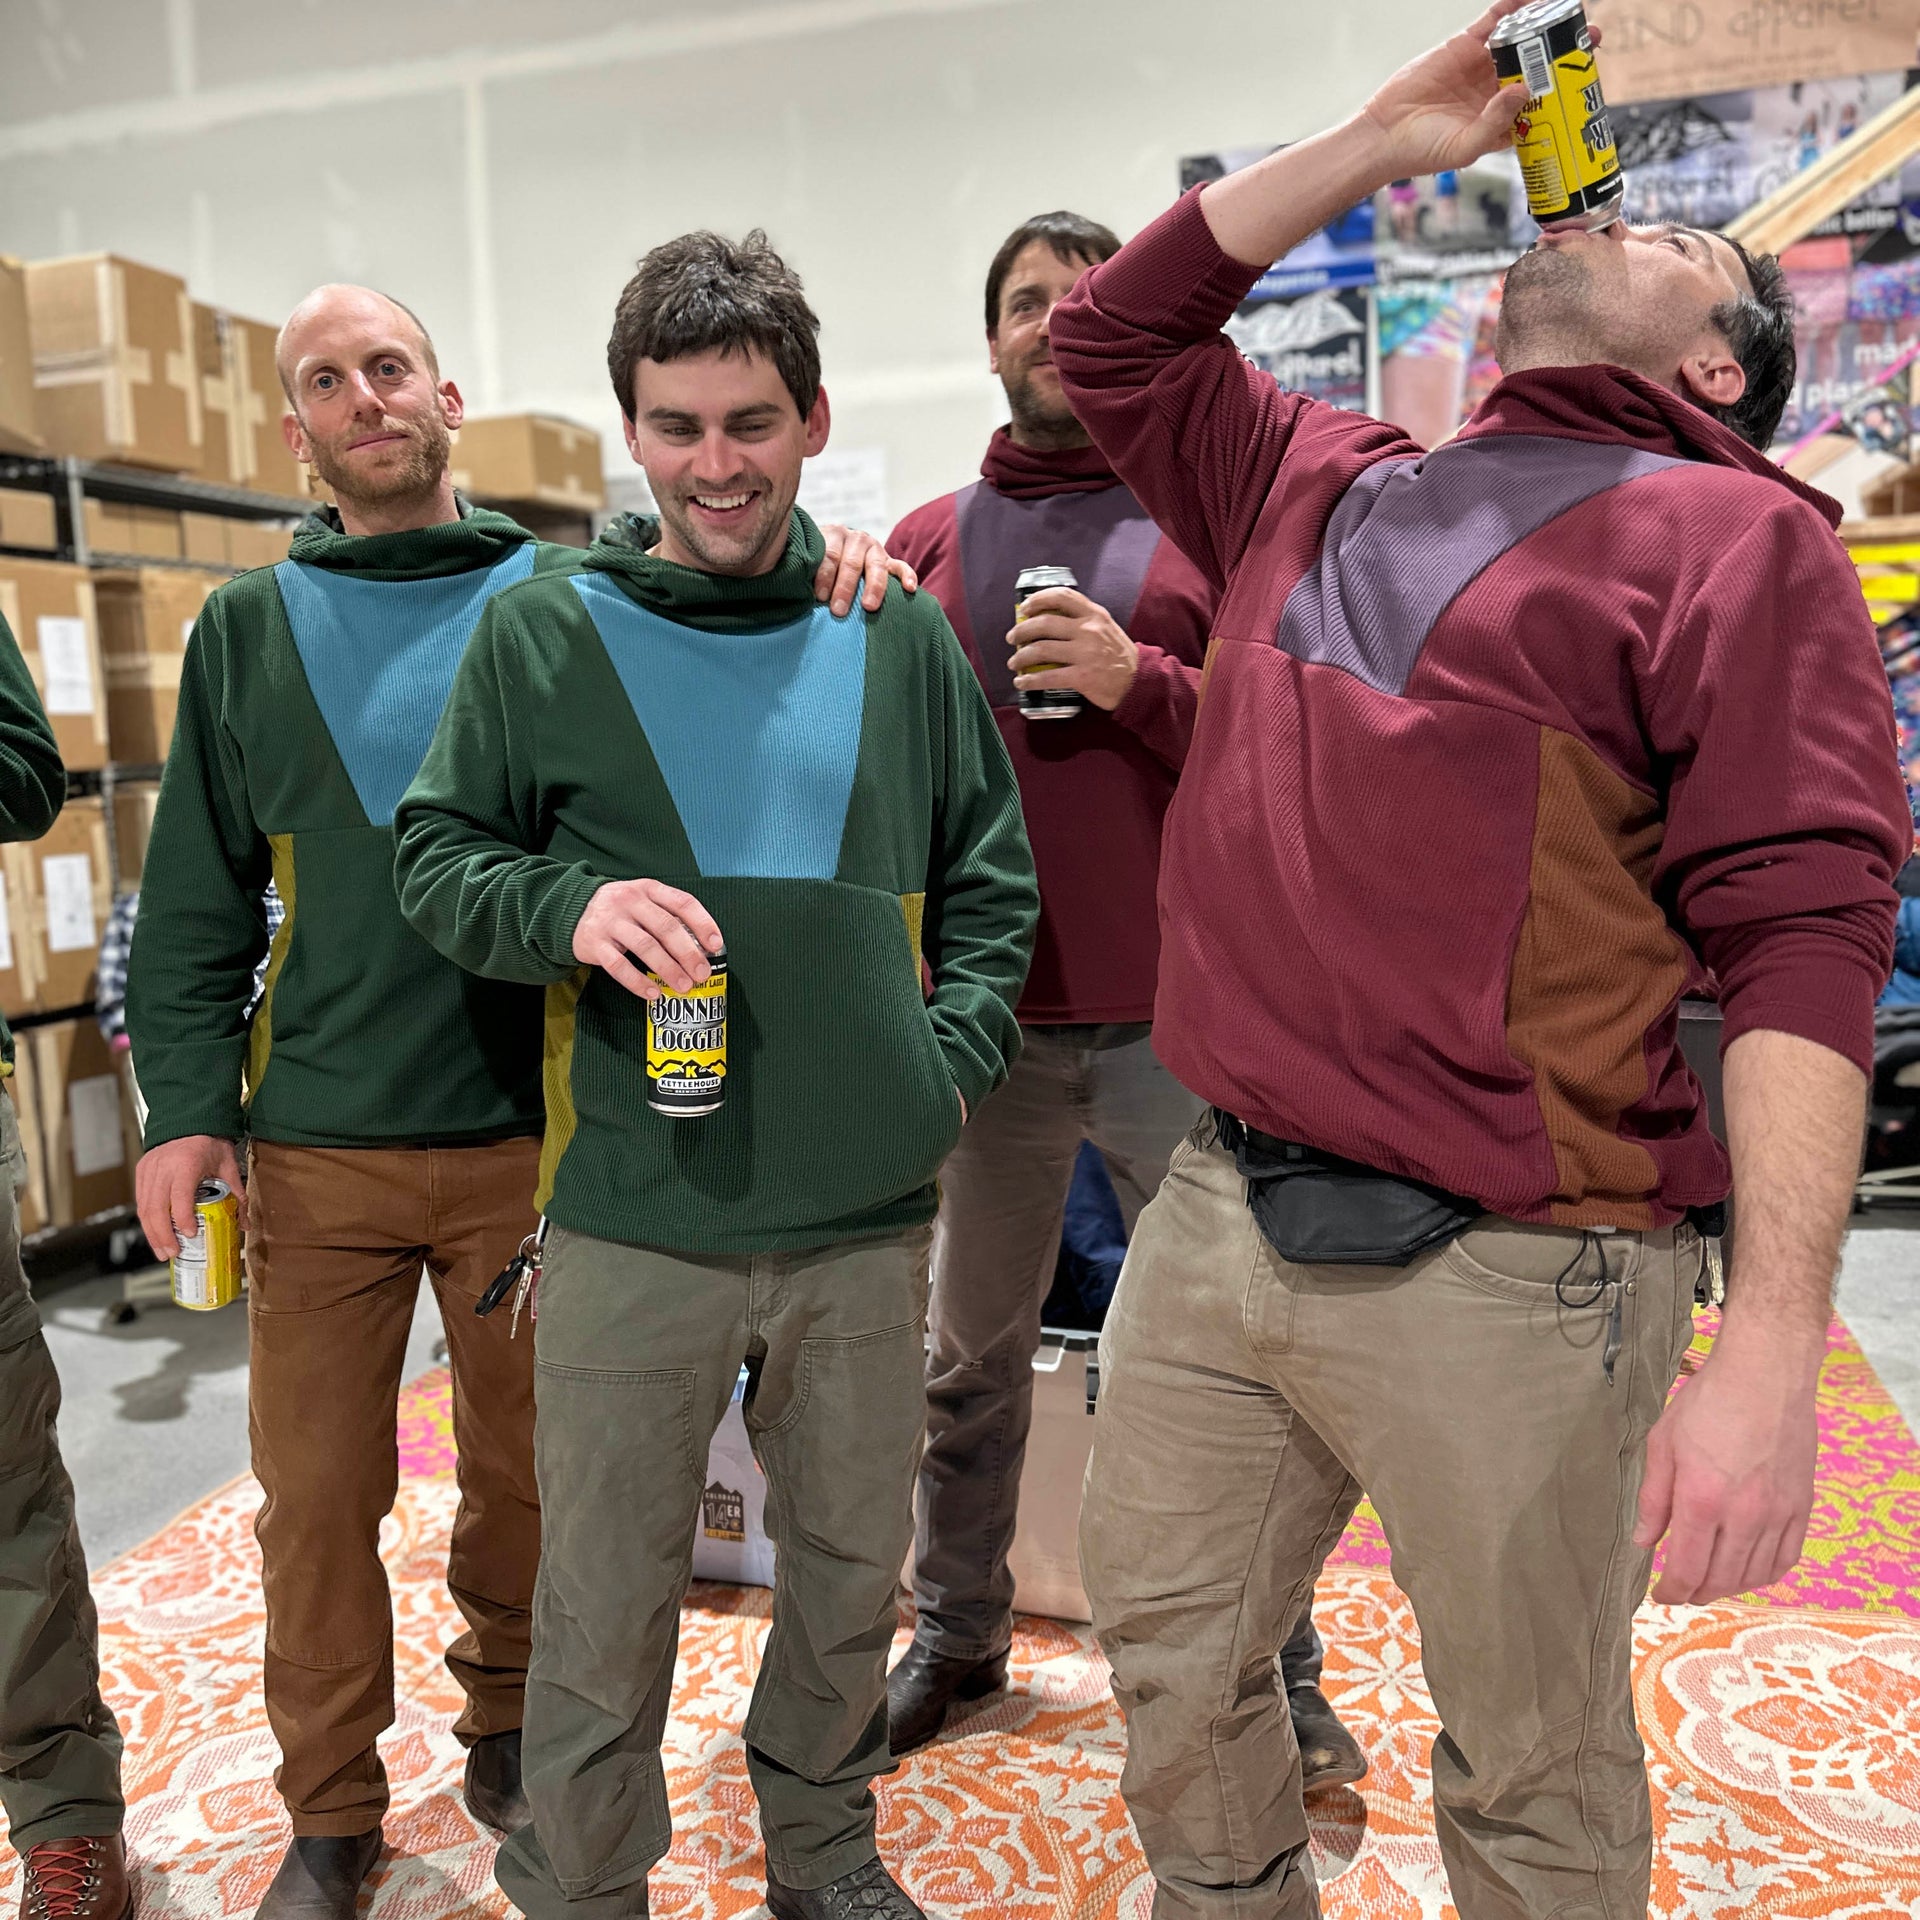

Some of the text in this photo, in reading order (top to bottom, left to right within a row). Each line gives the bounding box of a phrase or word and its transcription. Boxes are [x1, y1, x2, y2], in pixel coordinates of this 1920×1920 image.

[651, 994, 725, 1024] BONNER
[652, 1025, 725, 1052] LOGGER
[685, 1065, 698, 1078] K
[661, 1079, 719, 1088] KETTLEHOUSE
